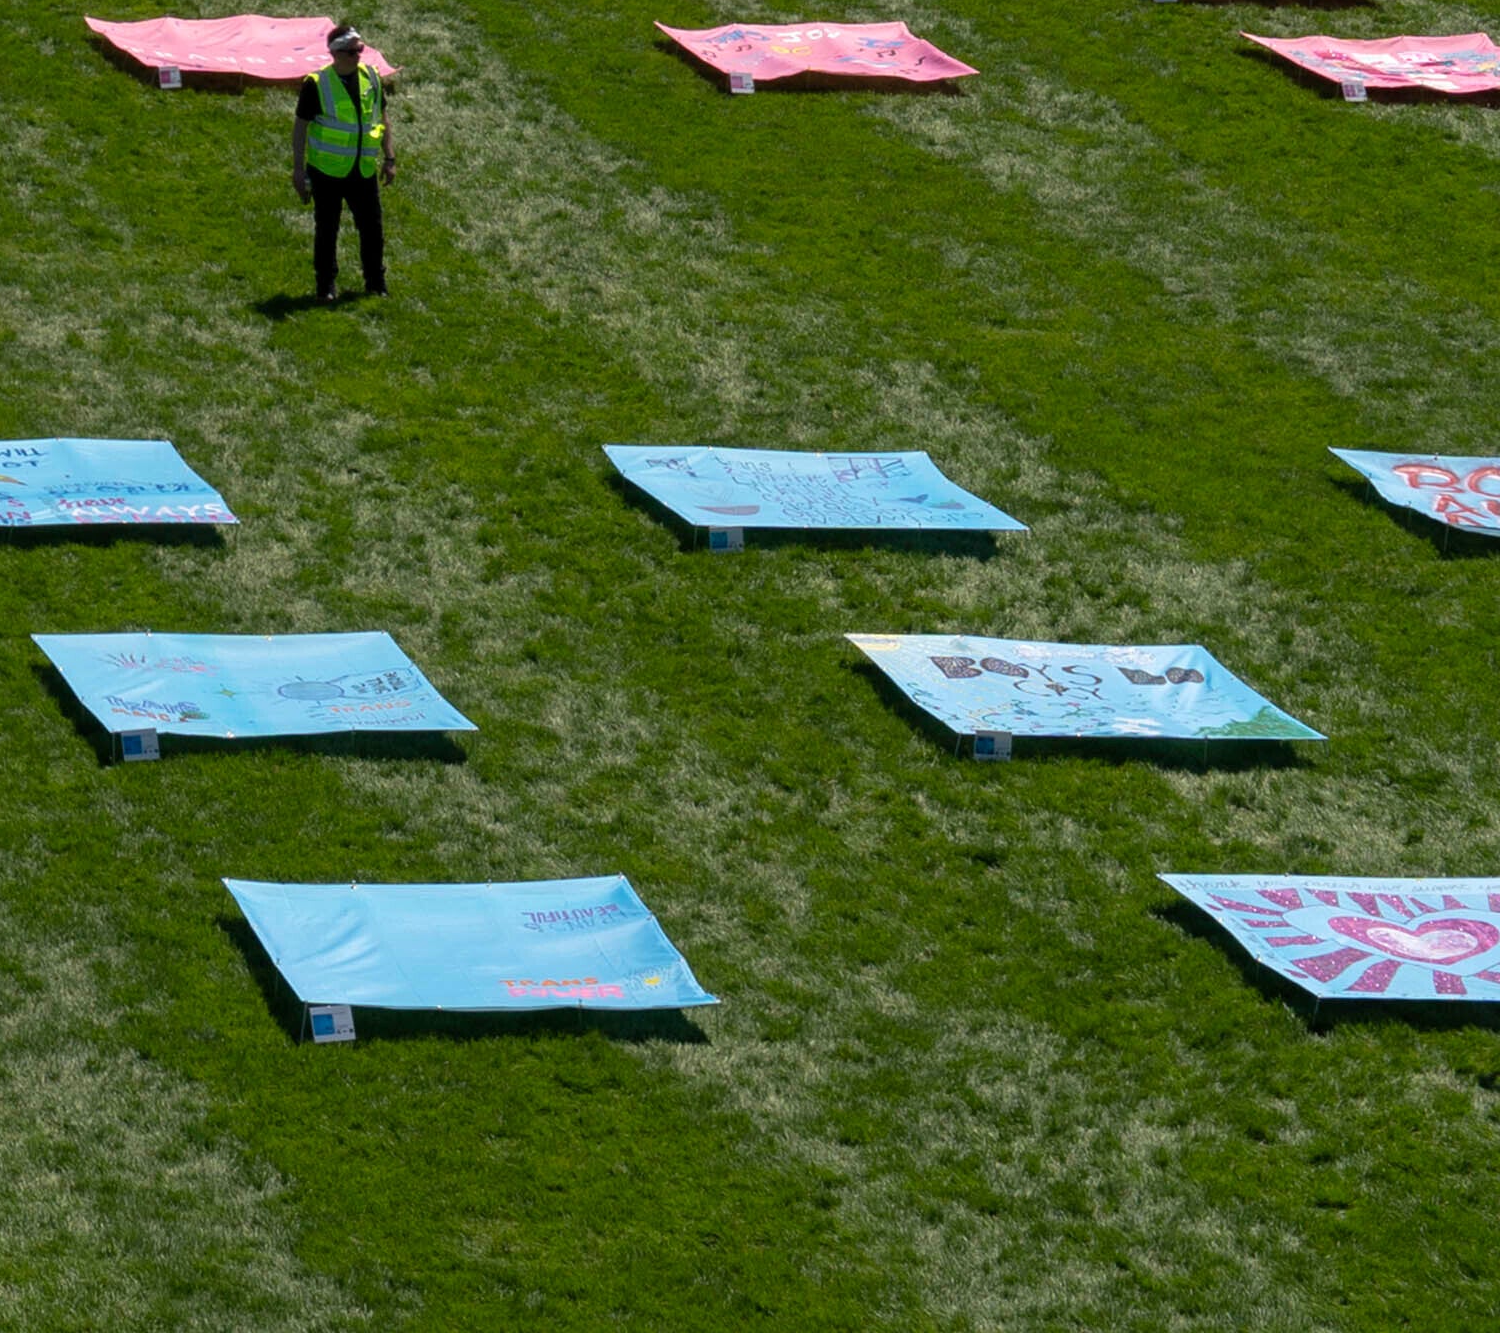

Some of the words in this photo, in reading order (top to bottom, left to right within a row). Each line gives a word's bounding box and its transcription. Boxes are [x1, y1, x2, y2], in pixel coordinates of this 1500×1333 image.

[71, 502, 224, 517] ALWAYS
[930, 655, 1103, 685] BOYS
[521, 904, 620, 924] BEAUTIFUL
